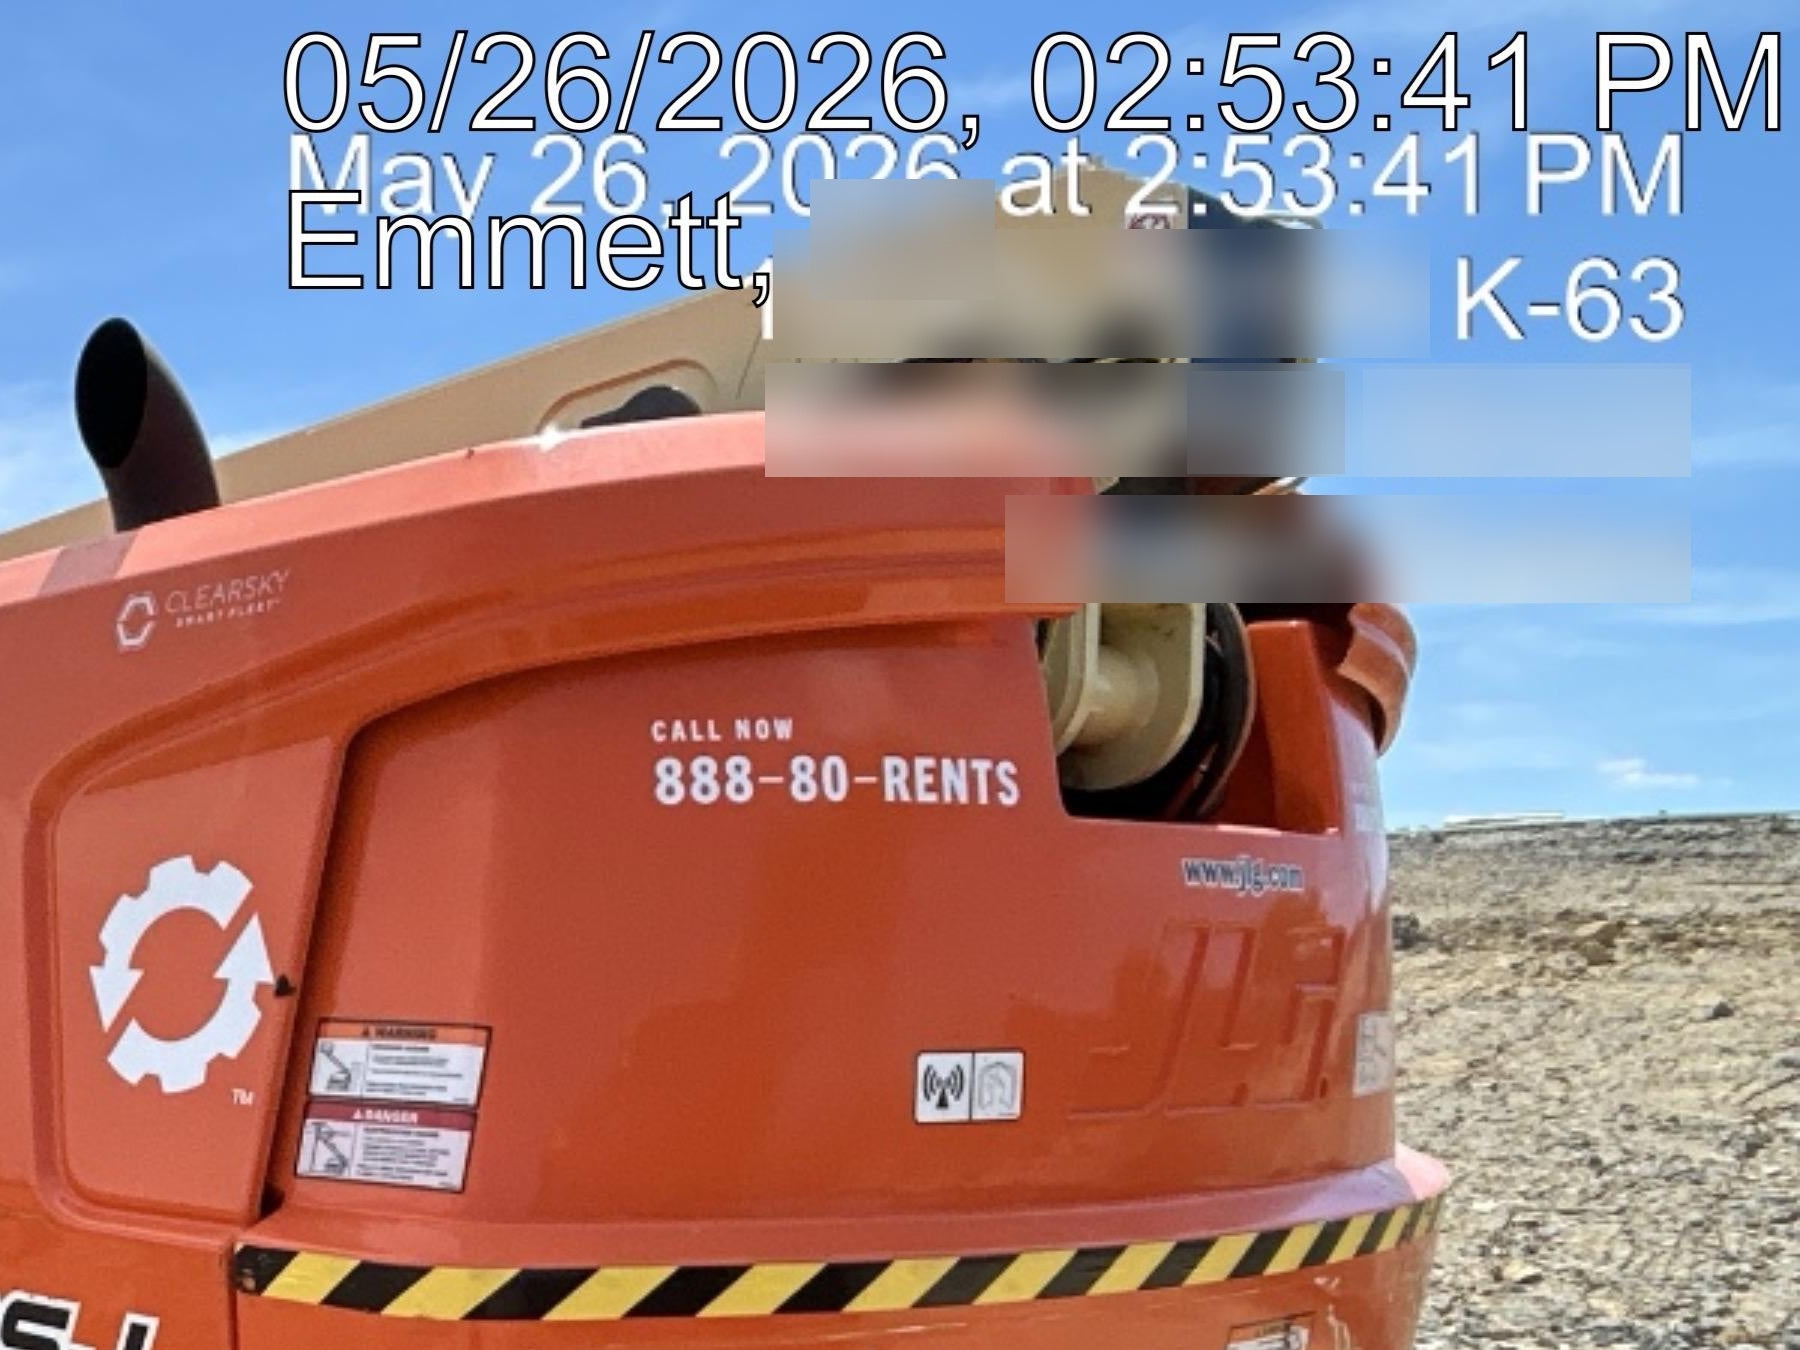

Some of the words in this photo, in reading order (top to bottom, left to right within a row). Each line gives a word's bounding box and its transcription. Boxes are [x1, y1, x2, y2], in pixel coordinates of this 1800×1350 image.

[164, 569, 291, 613] CLEARSKY
[650, 719, 722, 743] CALL
[734, 717, 794, 741] NOW
[653, 754, 1021, 807] 888-80-RENTS
[1181, 854, 1304, 896] www.jlg.com
